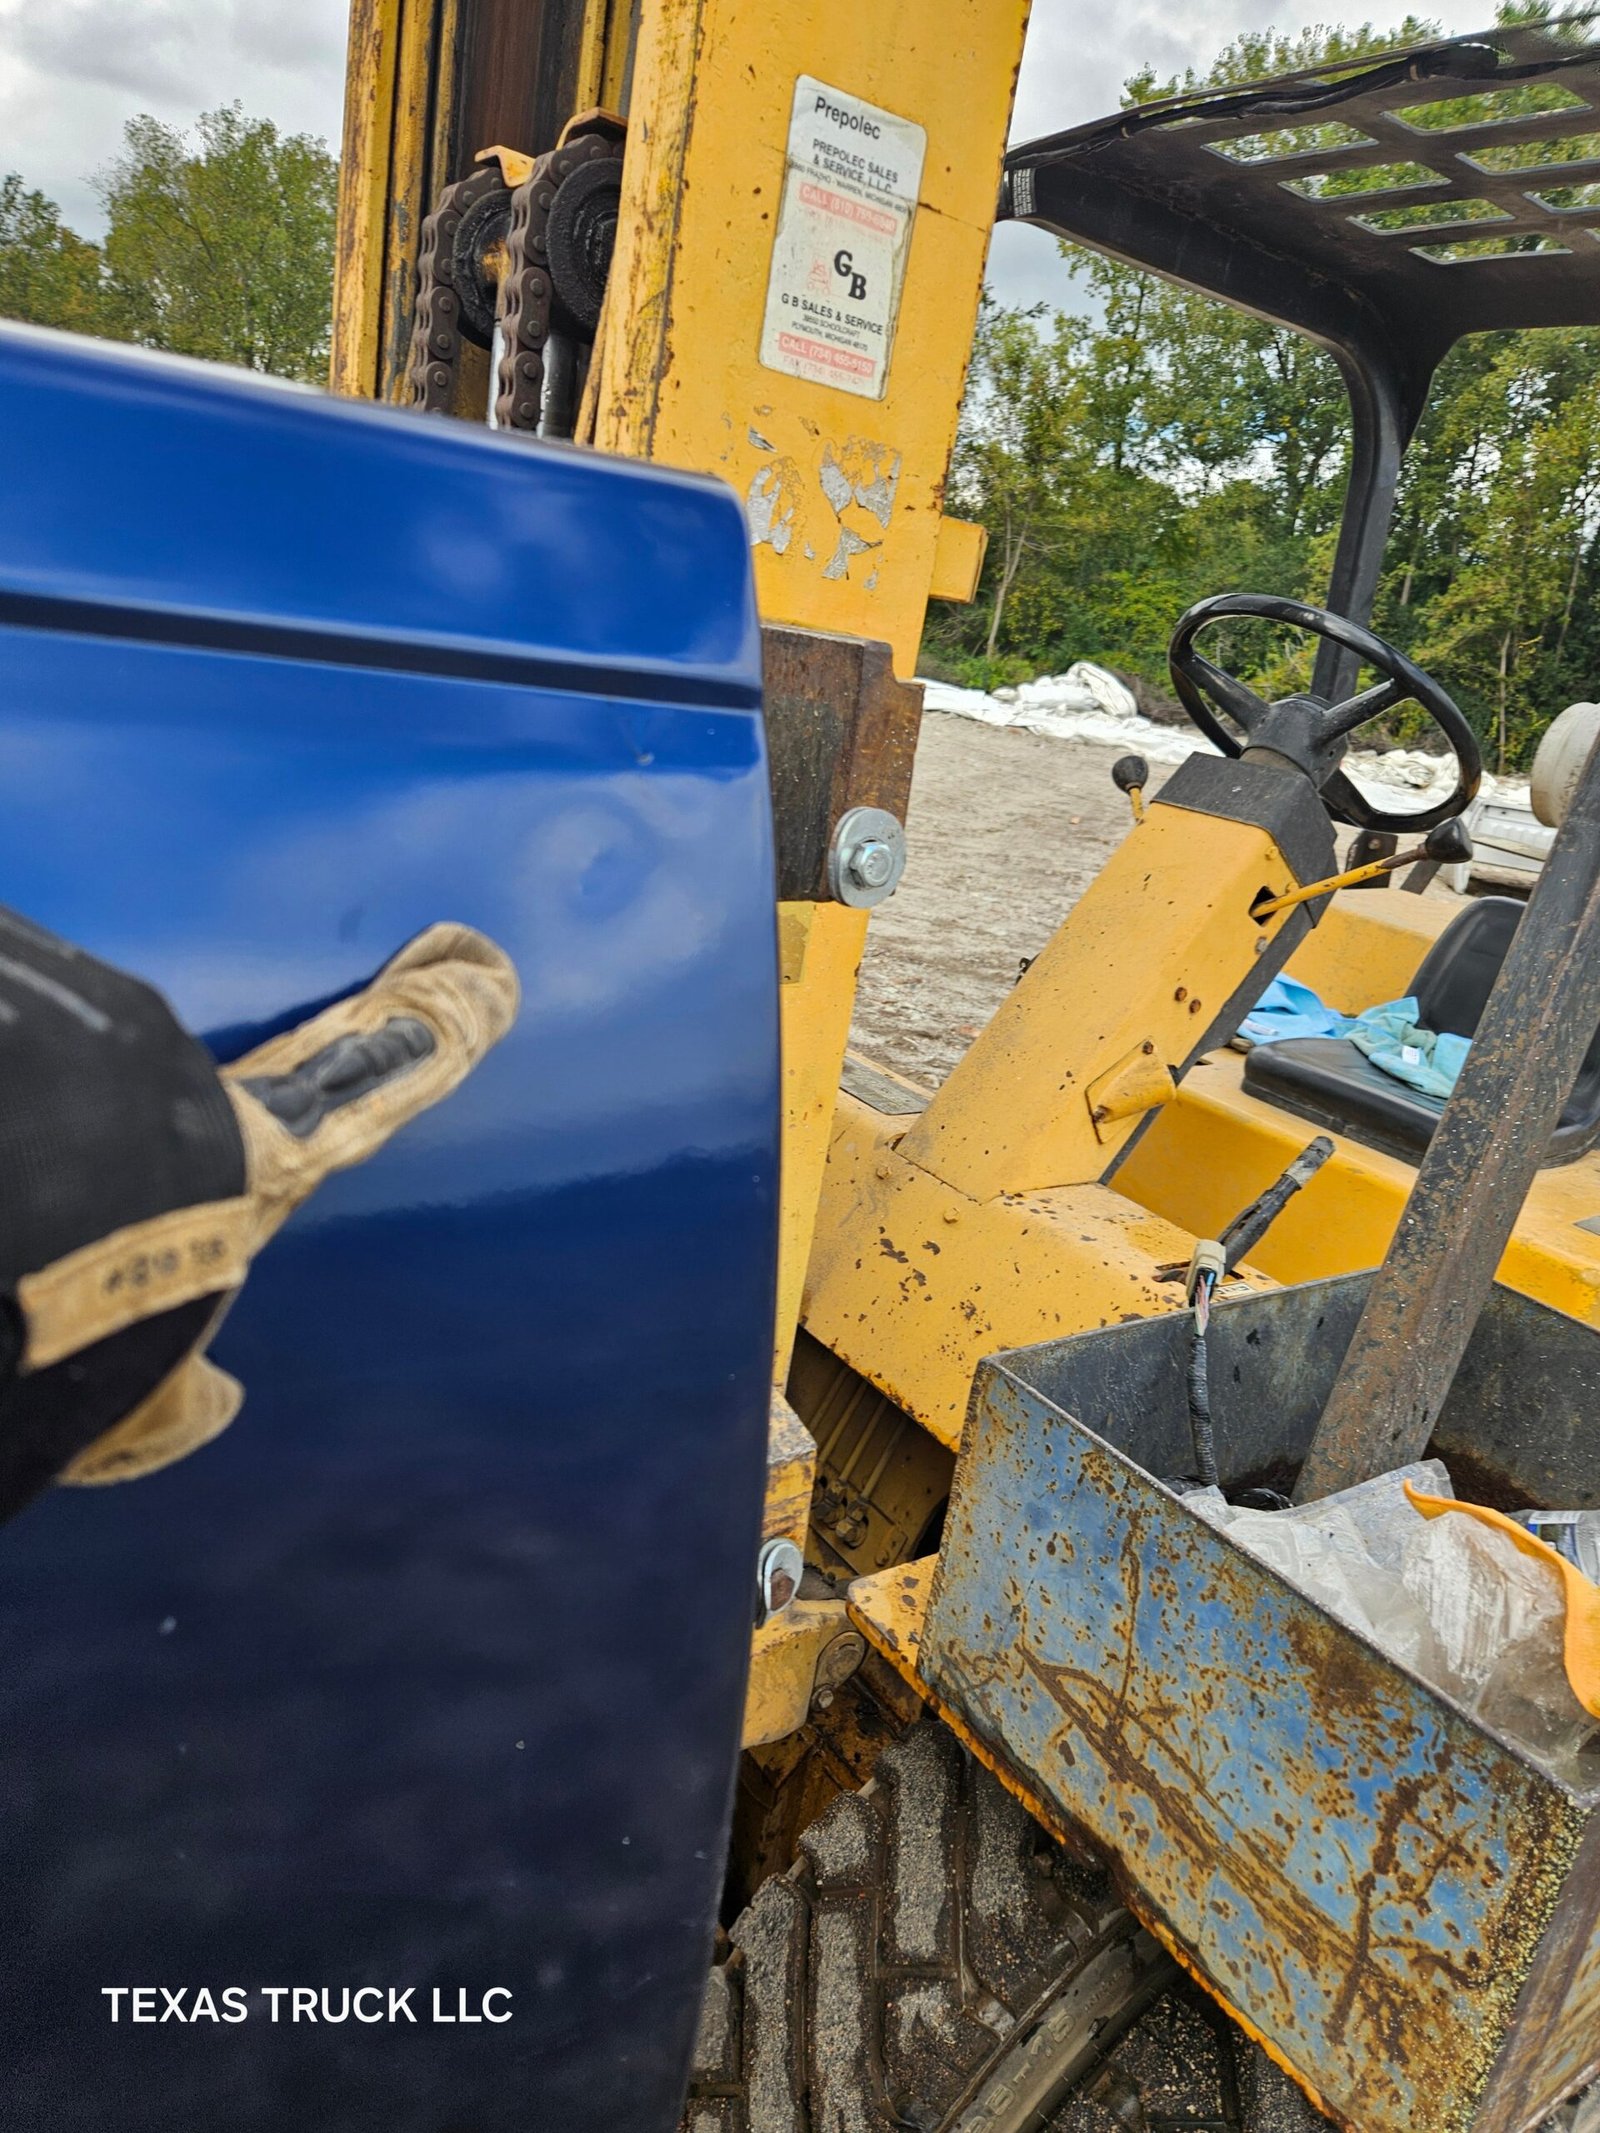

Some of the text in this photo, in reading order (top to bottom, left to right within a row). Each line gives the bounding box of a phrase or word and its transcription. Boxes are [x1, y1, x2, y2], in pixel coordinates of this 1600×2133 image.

[815, 97, 881, 140] Prepolec
[812, 138, 866, 169] PREPOLEC
[867, 161, 899, 183] SALES
[813, 153, 820, 166] &
[801, 183, 829, 205] CALL
[781, 292, 883, 336] G B SALES & SERVICE
[781, 336, 807, 355] CALL
[824, 331, 852, 347] MICHIGAN
